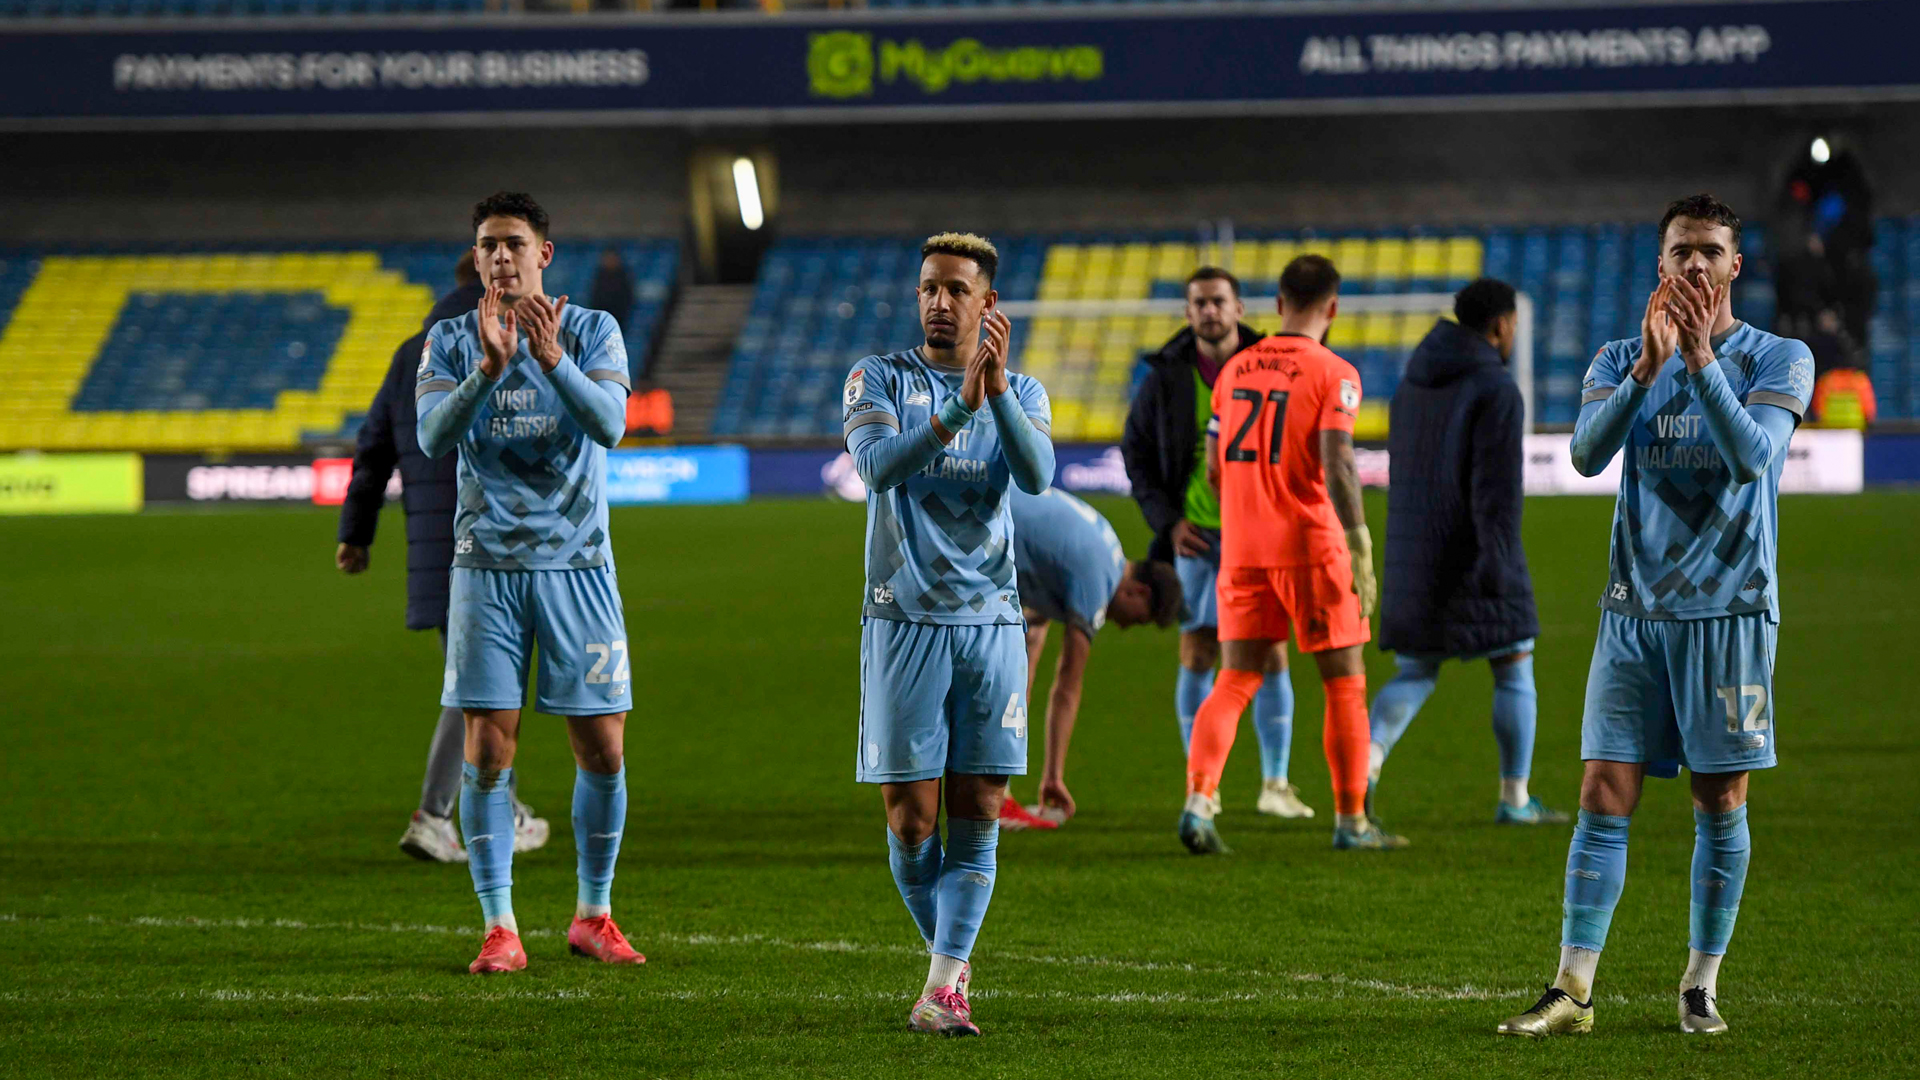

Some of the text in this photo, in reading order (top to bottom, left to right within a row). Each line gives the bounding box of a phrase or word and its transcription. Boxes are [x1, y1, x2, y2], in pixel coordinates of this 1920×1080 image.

[114, 49, 649, 90] PAYMENTS FOR YOUR BUSINESS
[879, 38, 1103, 93] MyGuava
[1299, 24, 1771, 74] ALL THINGS PAYMENTS APP
[495, 389, 537, 411] VISIT
[1225, 388, 1289, 464] 21
[1657, 415, 1701, 438] VISIT
[1636, 445, 1722, 469] MALAYSIA
[874, 587, 894, 604] 125
[585, 640, 630, 684] 22
[1002, 692, 1026, 738] 4
[1717, 685, 1769, 732] 12
